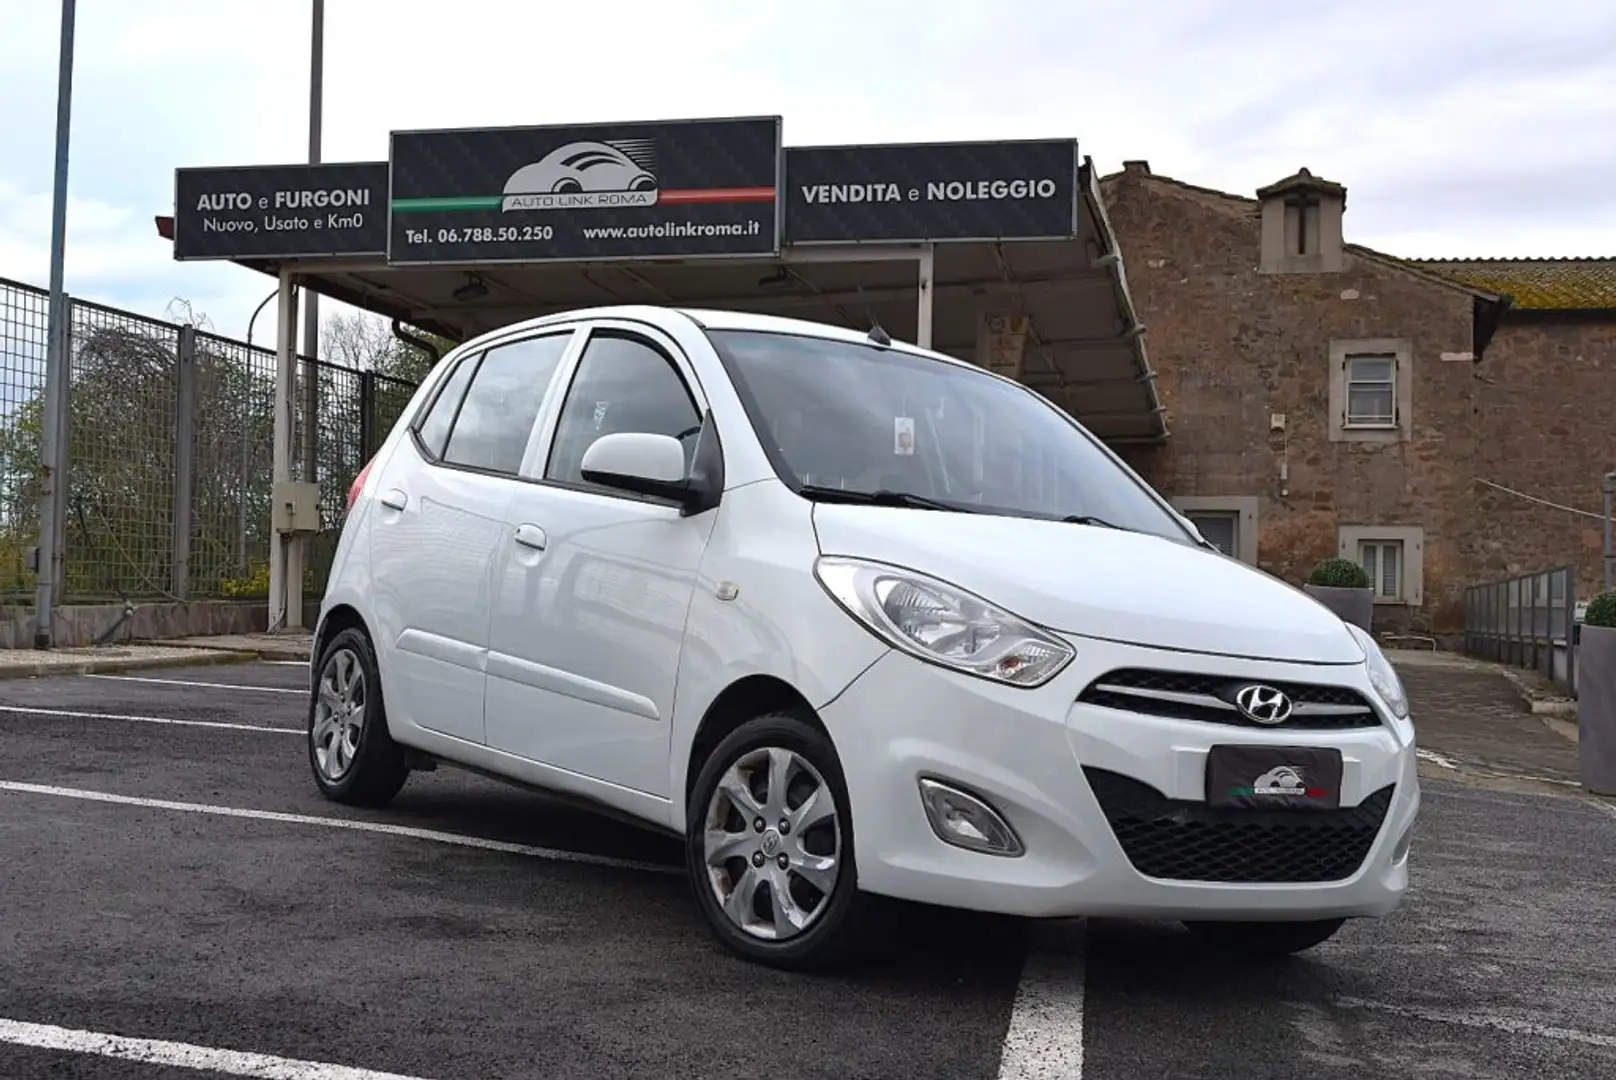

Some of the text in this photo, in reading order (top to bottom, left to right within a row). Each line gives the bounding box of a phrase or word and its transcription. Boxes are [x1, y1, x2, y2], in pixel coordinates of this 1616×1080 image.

[197, 189, 369, 211] AUTO e FURGONI
[511, 194, 647, 207] AUTO LINK ROMA
[802, 179, 1056, 203] VENDITA e NOLEGGIO
[203, 213, 363, 233] Nuovo, Usato e Km0
[583, 220, 760, 239] www.autolinkroma.it
[405, 226, 553, 243] Tel. 06.788.50.250
